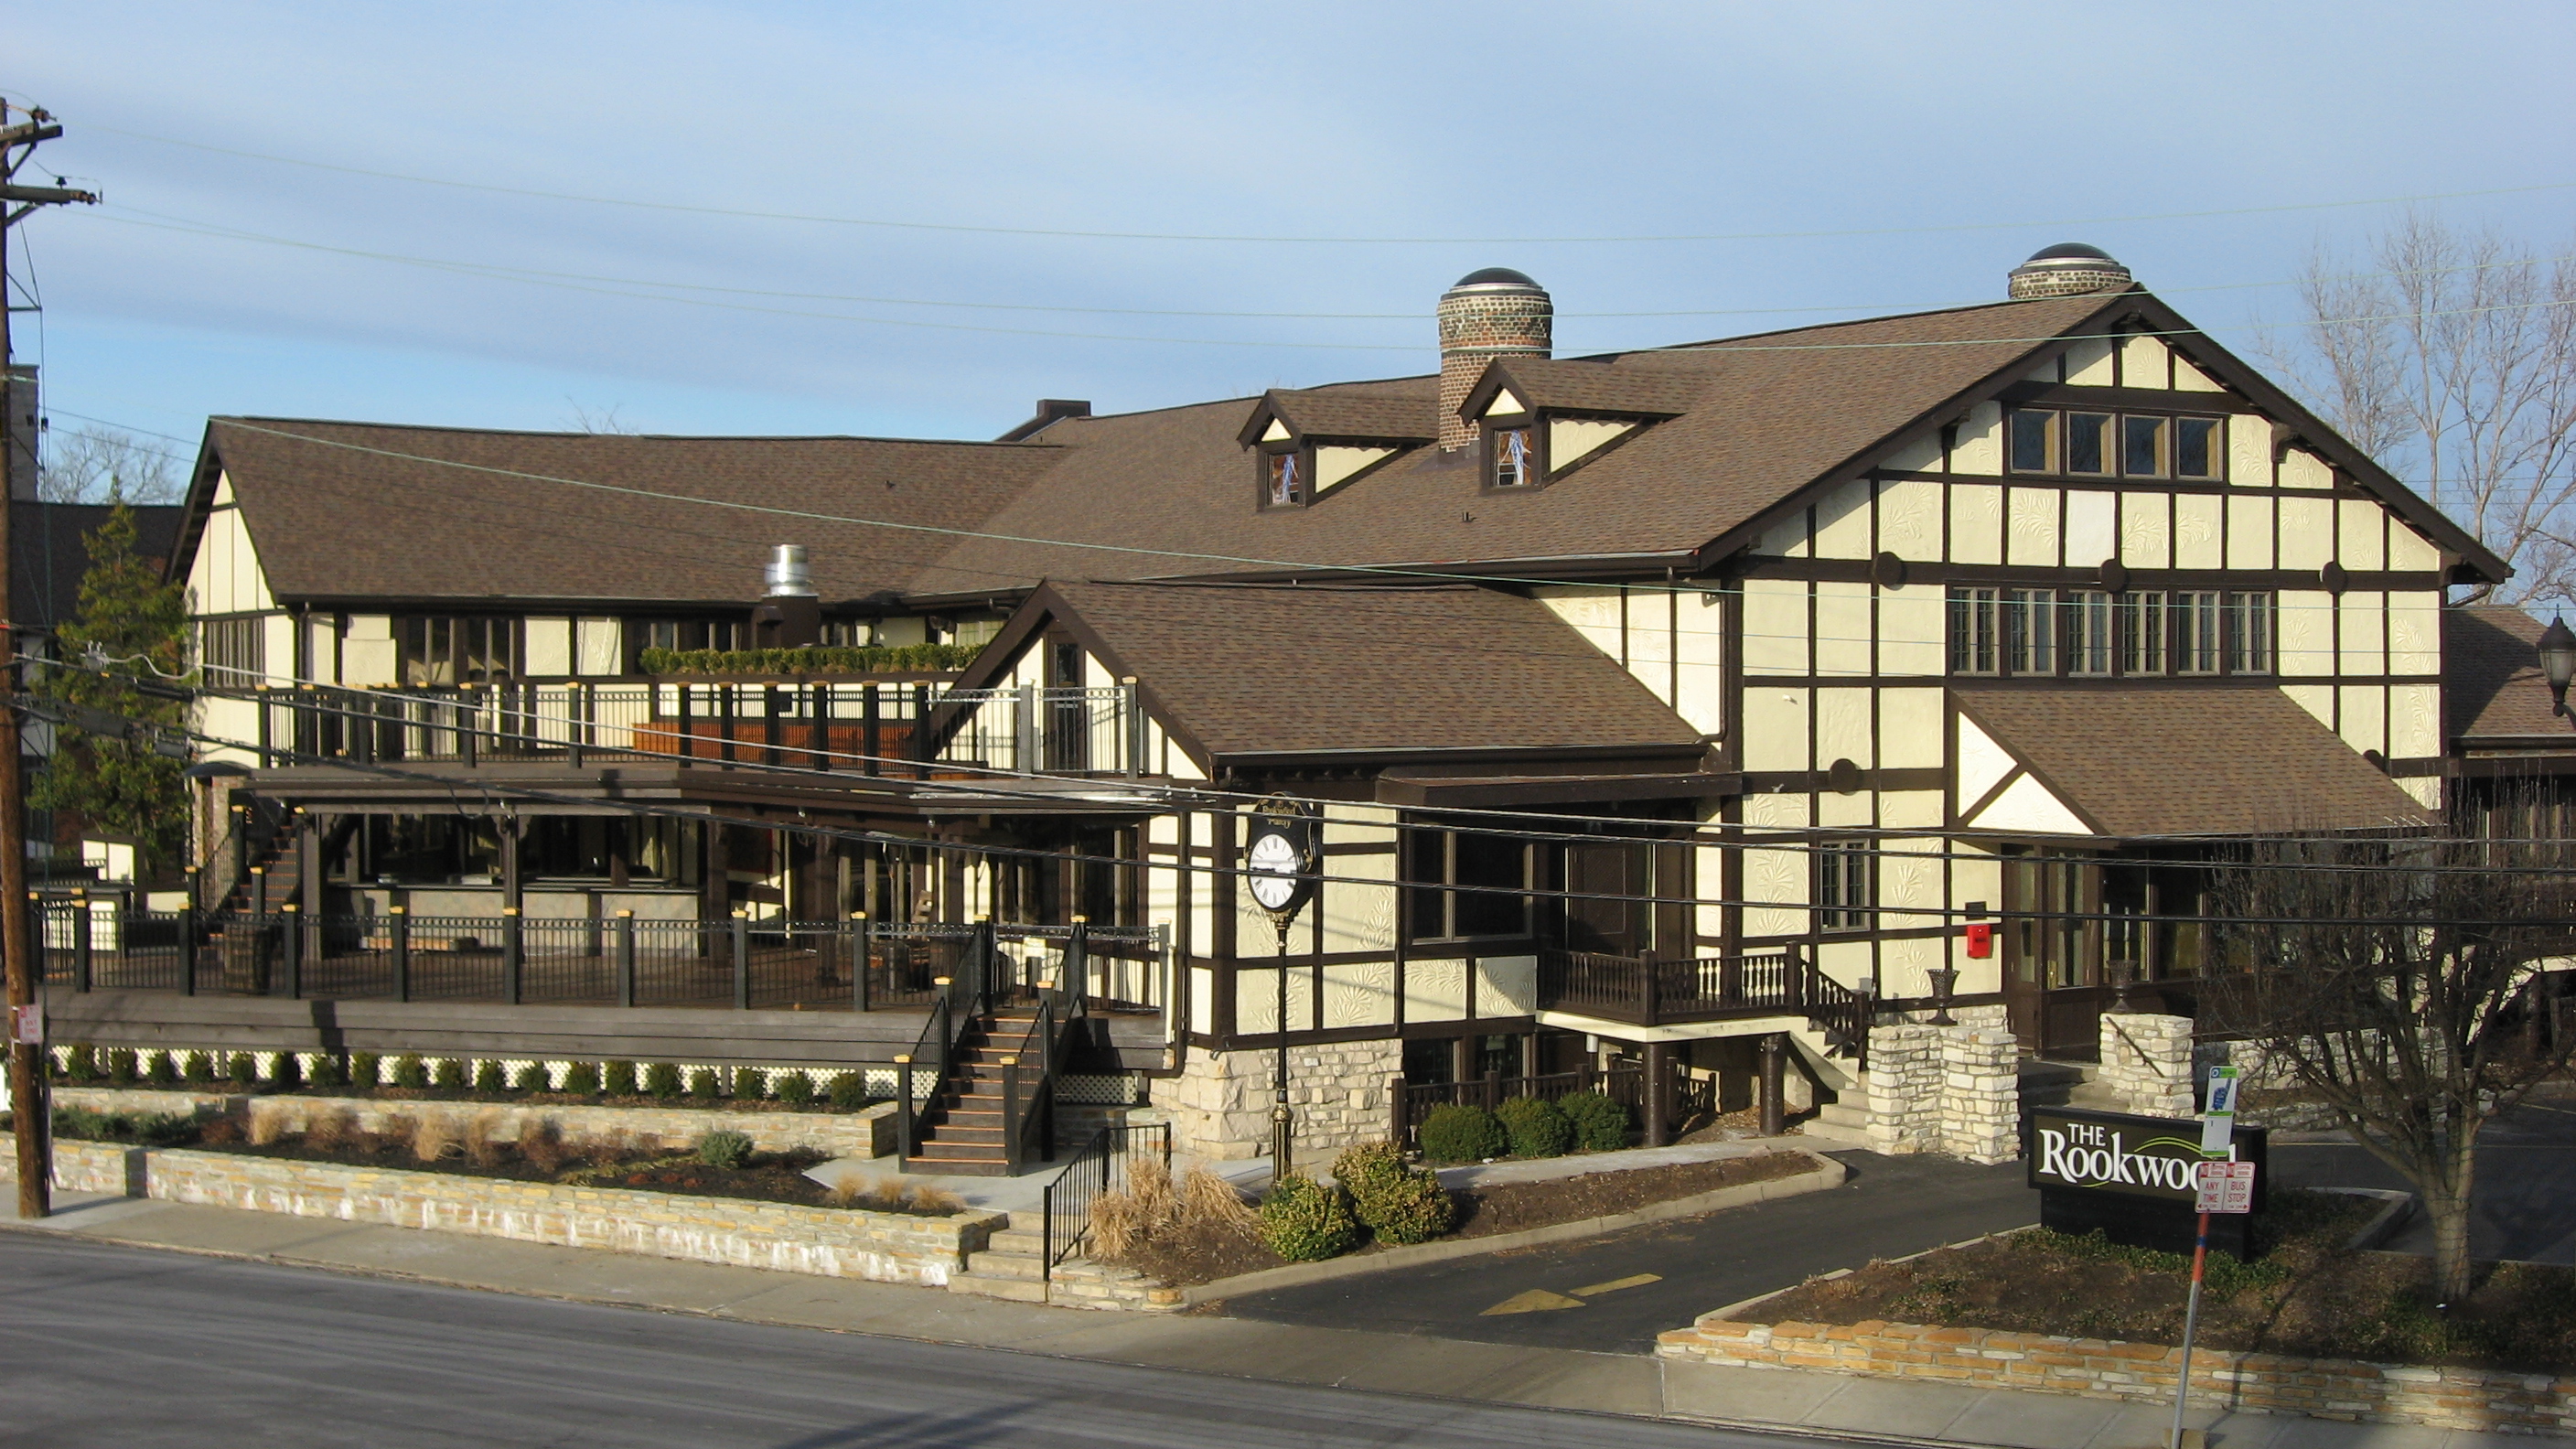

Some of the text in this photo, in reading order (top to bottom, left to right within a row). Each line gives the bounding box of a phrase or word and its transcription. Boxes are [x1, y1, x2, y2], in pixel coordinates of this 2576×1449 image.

[2066, 1122, 2107, 1147] THE
[2205, 1181, 2220, 1190] ANY
[2230, 1181, 2247, 1191] BUS
[2203, 1192, 2219, 1203] TIME
[2227, 1193, 2247, 1203] STOP
